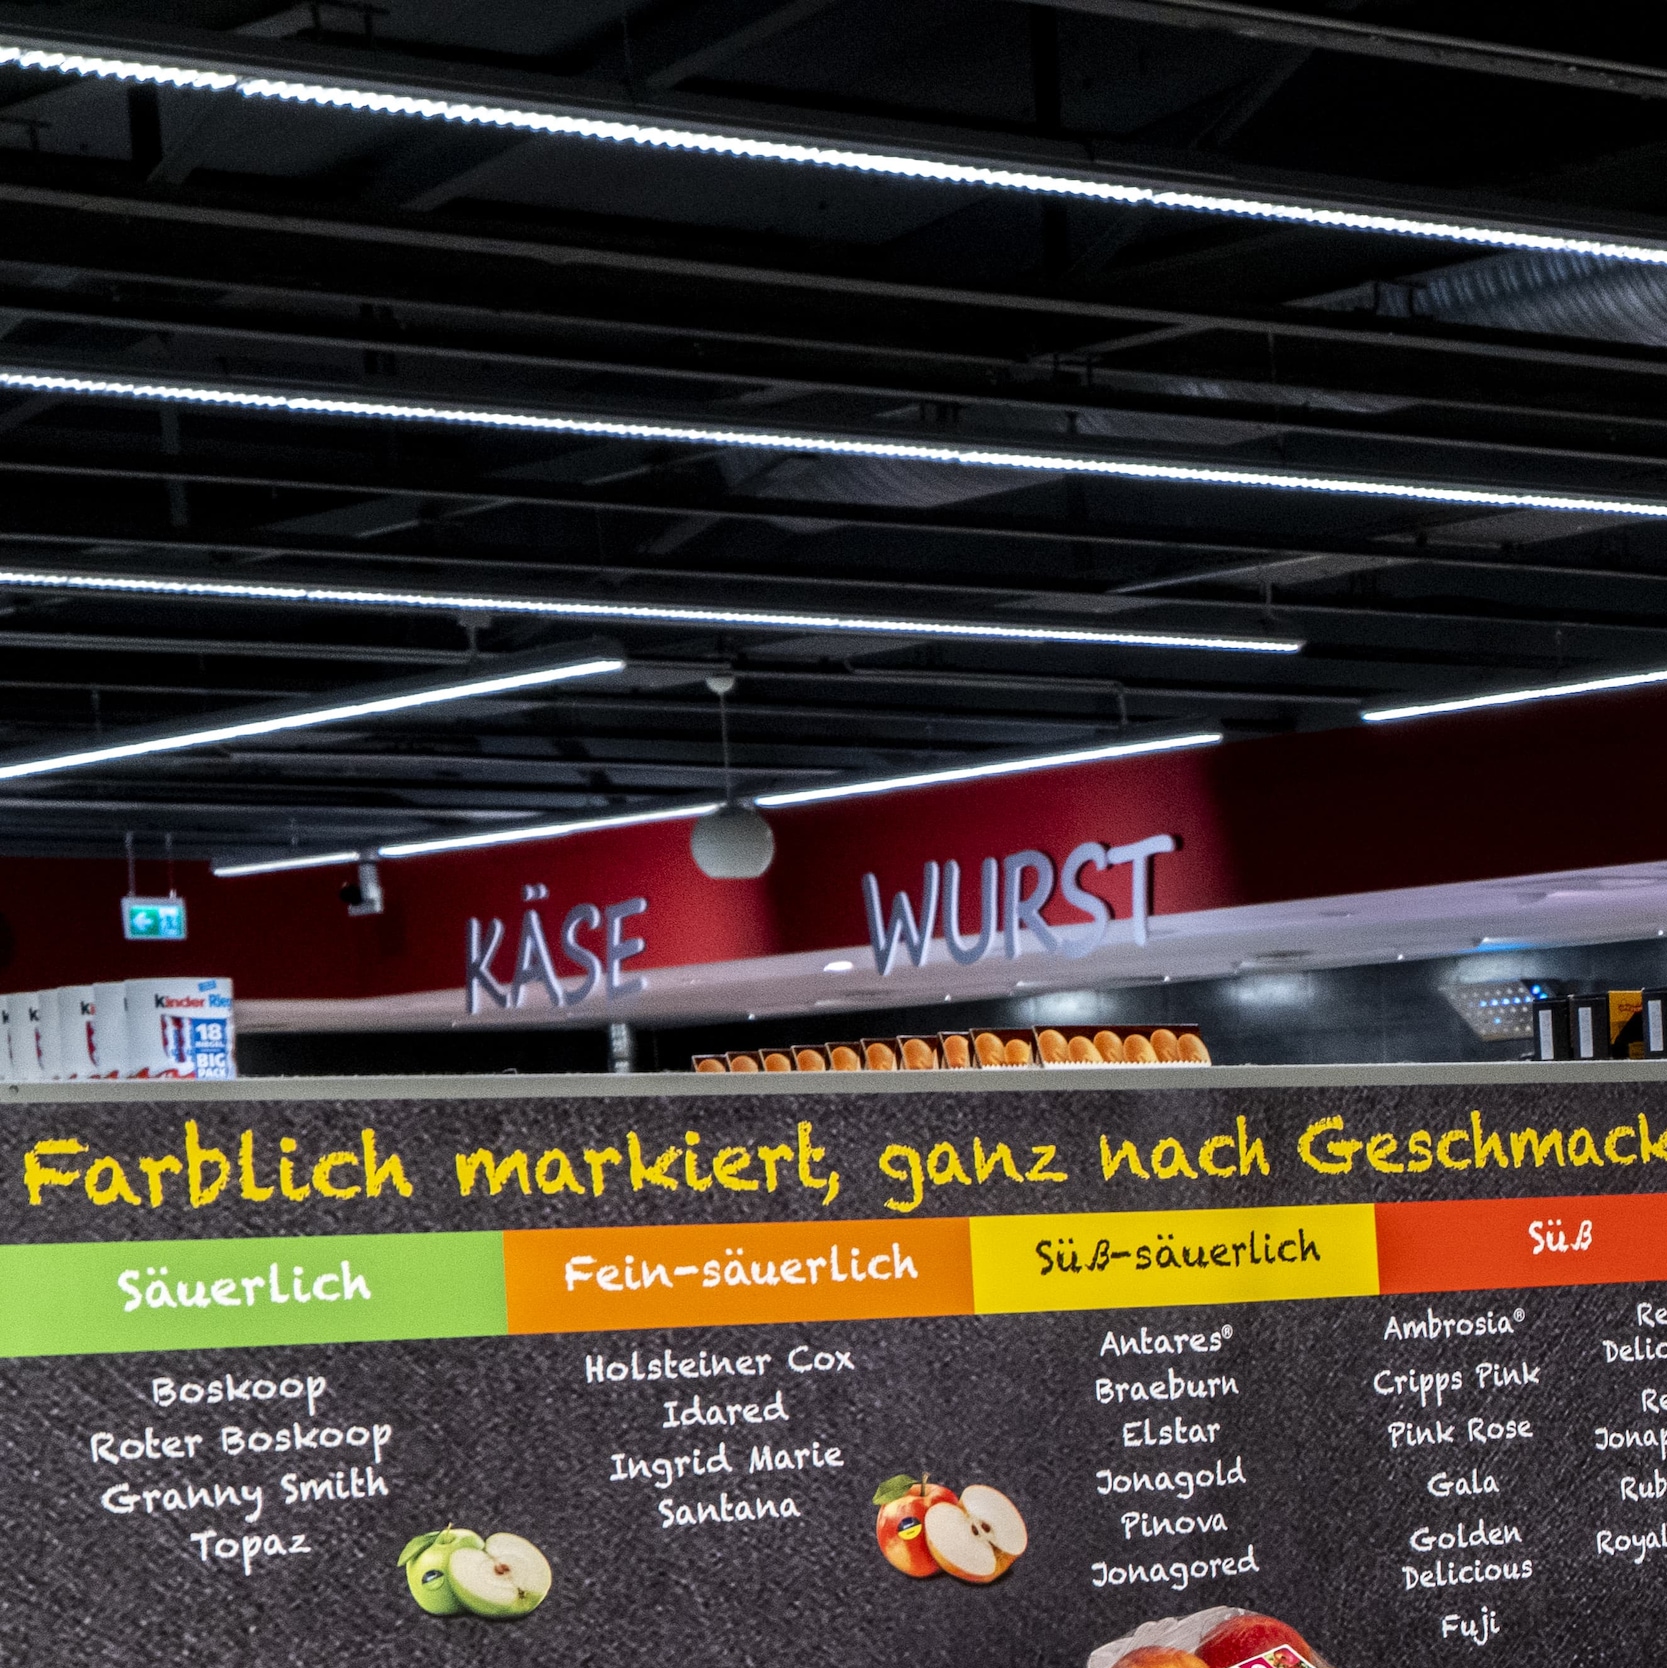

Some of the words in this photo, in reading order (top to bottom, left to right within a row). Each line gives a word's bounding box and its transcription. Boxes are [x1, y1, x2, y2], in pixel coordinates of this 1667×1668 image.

[861, 834, 1182, 976] WURST
[464, 883, 648, 1015] KÄSE
[155, 994, 205, 1010] kinder
[195, 1023, 222, 1041] 18
[196, 1053, 226, 1068] BIG
[23, 1116, 414, 1210] Farblich
[455, 1119, 842, 1206] markiert,
[878, 1136, 1068, 1213] ganz
[1100, 1114, 1271, 1181] nach
[1038, 1227, 1322, 1277] Süß-säuerlich
[1527, 1217, 1595, 1257] Süß
[117, 1259, 372, 1313] Säuerlich
[564, 1240, 919, 1293] Fein-säuerlich
[585, 1347, 772, 1386] Holsteiner
[786, 1344, 856, 1376] Cox
[1373, 1370, 1463, 1407] Cripps
[1475, 1360, 1540, 1390] Pink
[152, 1371, 327, 1411] Boskoop
[1095, 1369, 1239, 1405] Braeburn
[662, 1396, 788, 1430] Idared
[1387, 1418, 1456, 1450] Pink
[1467, 1415, 1535, 1444] Rose
[90, 1430, 203, 1464] Roter
[221, 1422, 393, 1468] Boskoop
[1121, 1418, 1220, 1449] Elstar
[609, 1442, 733, 1489] Ingrid
[748, 1441, 845, 1474] Marie
[1095, 1457, 1247, 1499] Jonagold
[1425, 1470, 1500, 1499] Gala
[101, 1480, 264, 1523] Granny
[280, 1469, 389, 1505] Smith
[656, 1493, 801, 1529] Santana
[1121, 1510, 1229, 1542] Pinova
[1409, 1521, 1523, 1554] Golden
[190, 1529, 312, 1577] Topaz
[1090, 1549, 1259, 1593] Jonagored
[1401, 1556, 1534, 1593] Delicious
[1441, 1611, 1501, 1646] Fuji
